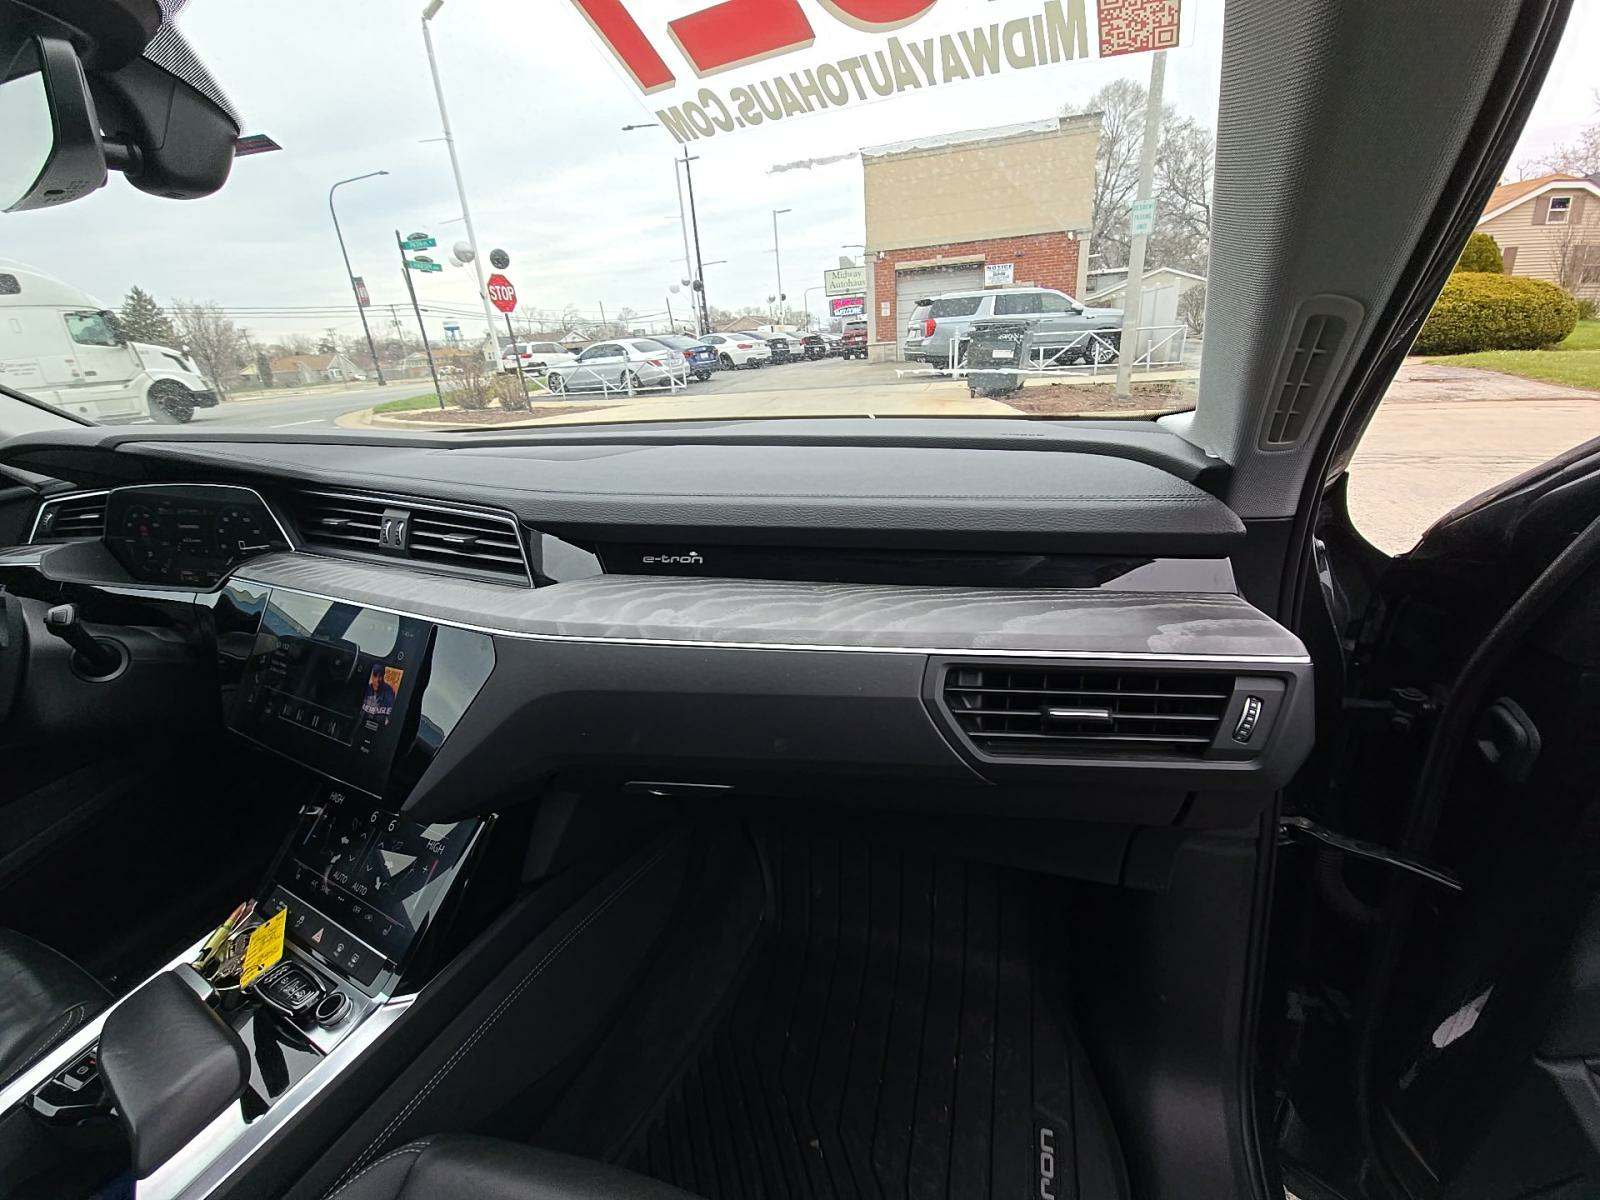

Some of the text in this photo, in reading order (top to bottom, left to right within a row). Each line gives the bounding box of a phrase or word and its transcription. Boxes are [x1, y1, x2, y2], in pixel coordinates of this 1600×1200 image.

[831, 270, 862, 279] Midway
[830, 279, 866, 289] Autohaus
[489, 285, 515, 301] STOP
[834, 306, 862, 316] WELCOME
[642, 553, 704, 564] e-tron
[330, 791, 346, 804] HIGH
[370, 811, 379, 823] 6
[388, 820, 397, 831] 6
[426, 840, 446, 855] HIGH
[331, 869, 349, 884] AUTO
[351, 880, 369, 896] AUTO
